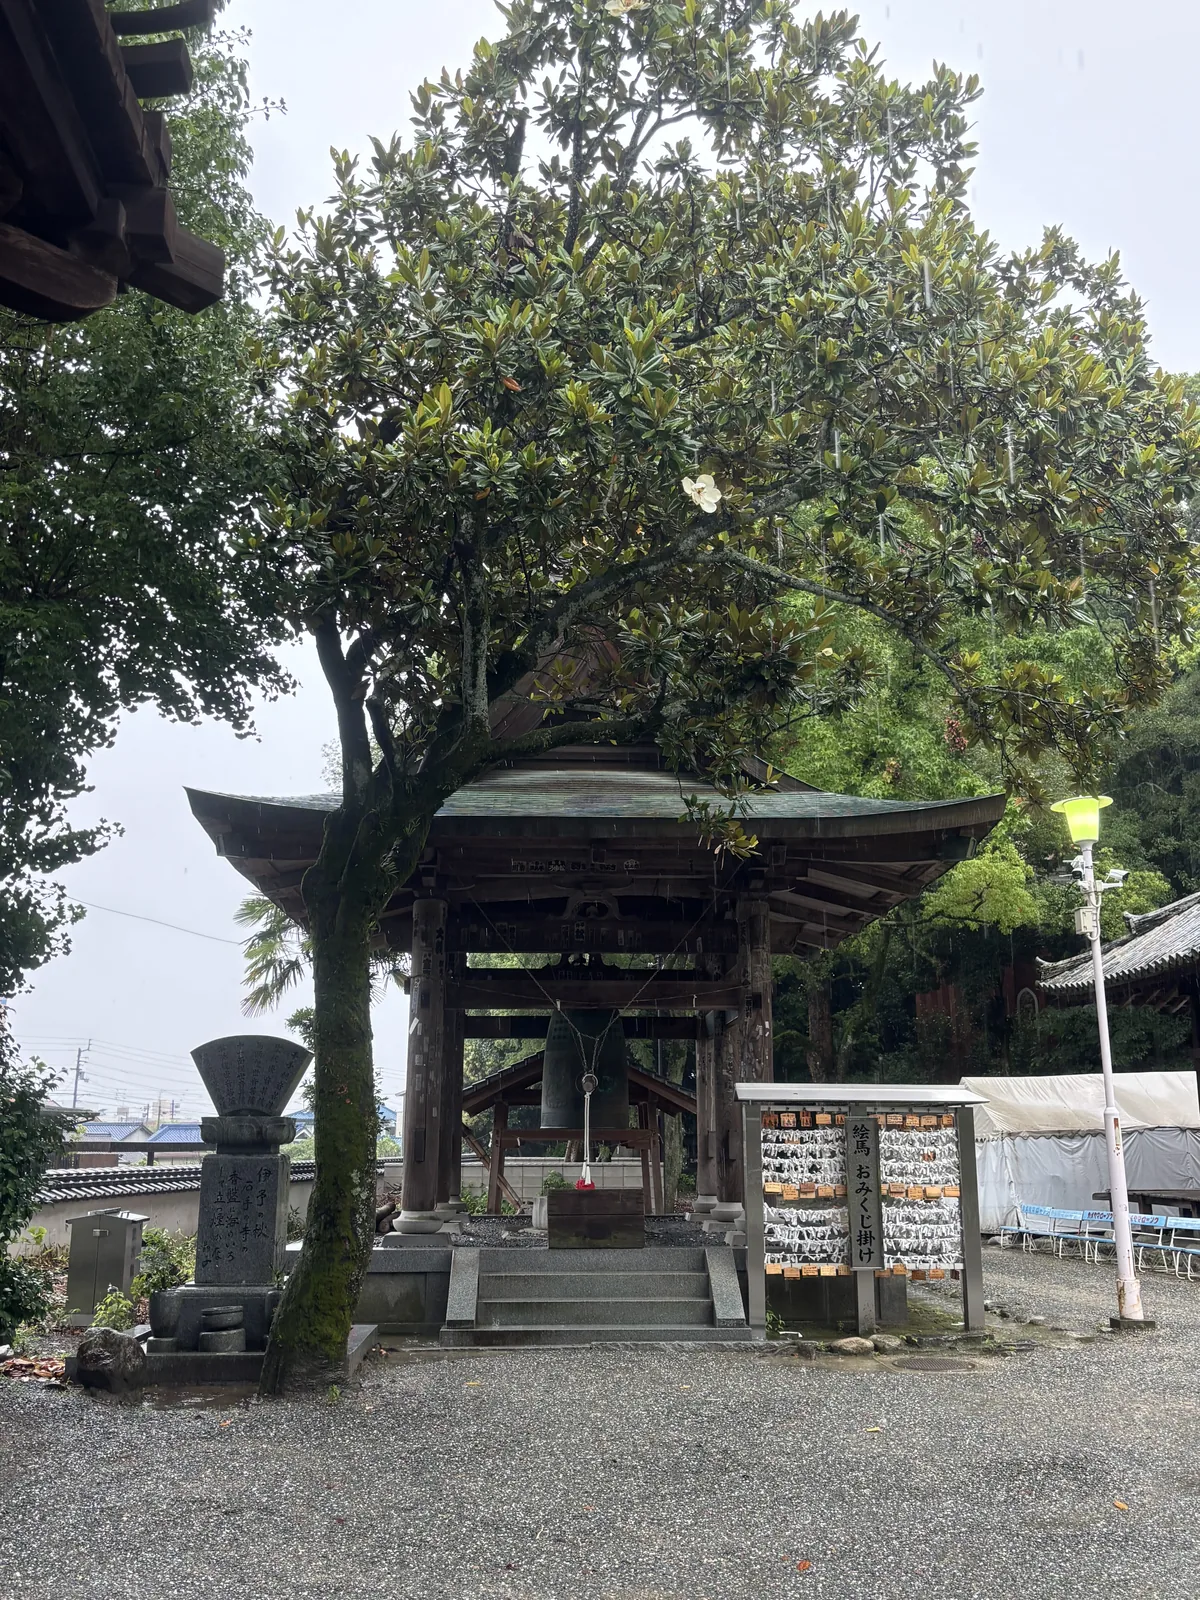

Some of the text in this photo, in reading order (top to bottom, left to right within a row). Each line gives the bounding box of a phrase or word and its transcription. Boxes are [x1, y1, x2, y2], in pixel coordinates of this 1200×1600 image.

[253, 1167, 272, 1238] 伊予の秋
[852, 1124, 876, 1263] 絵馬 おみくじ掛け
